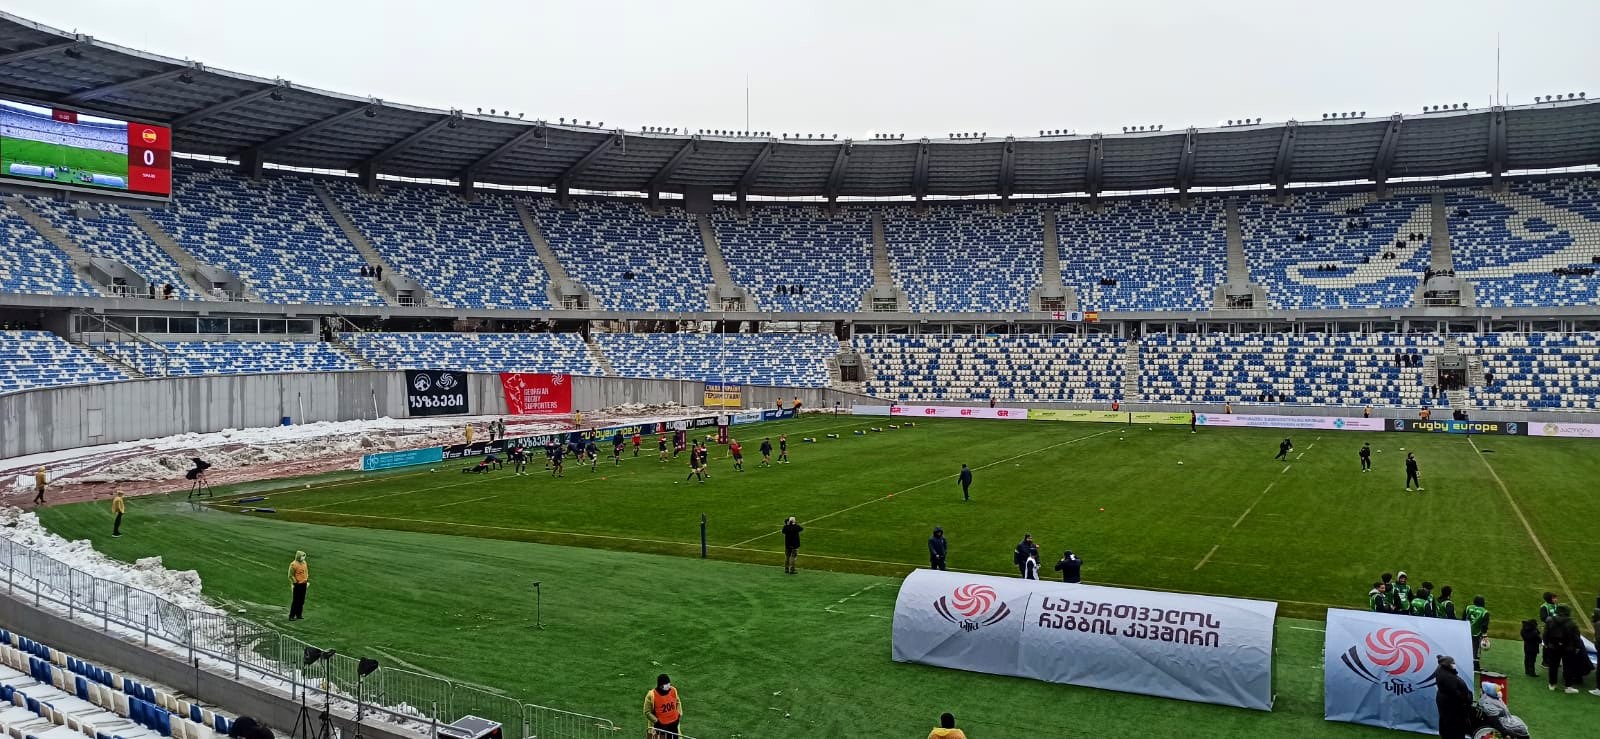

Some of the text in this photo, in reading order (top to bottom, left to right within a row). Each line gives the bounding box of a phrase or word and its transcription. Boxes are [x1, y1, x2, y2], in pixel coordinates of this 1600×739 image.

[143, 149, 154, 165] 0
[409, 393, 464, 408] ყაზბეგი
[524, 401, 558, 410] SUPPORTERS
[1412, 421, 1498, 433] rugby europe
[442, 451, 450, 459] EY
[1042, 597, 1220, 629] საქართველოს
[1039, 612, 1219, 648] რაგბის კავშირი
